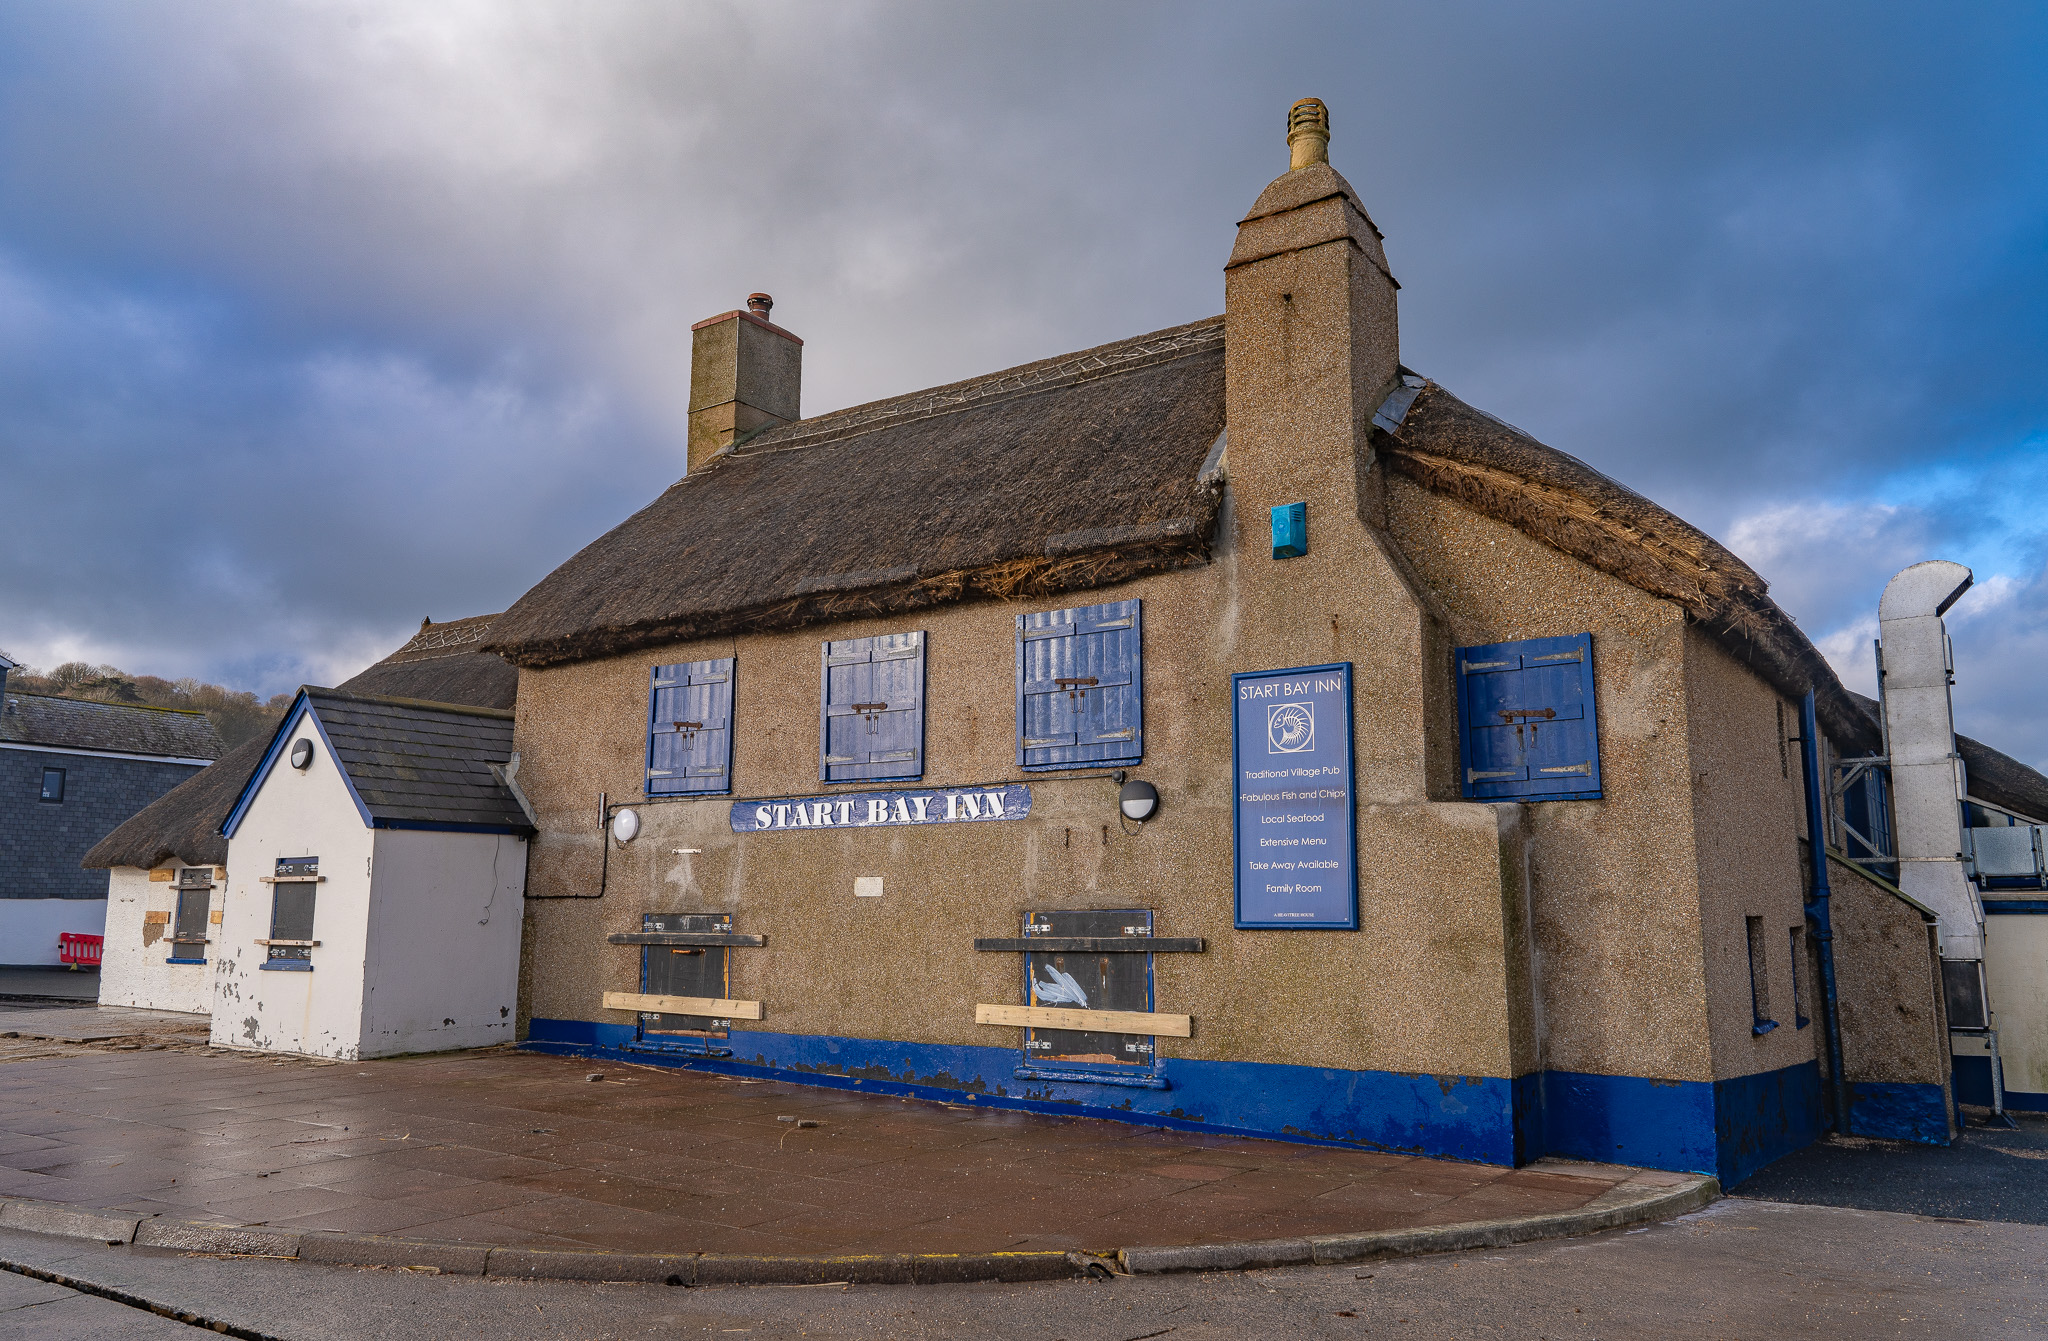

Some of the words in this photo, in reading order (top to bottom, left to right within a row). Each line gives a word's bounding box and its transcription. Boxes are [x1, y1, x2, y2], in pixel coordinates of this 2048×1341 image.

[1240, 684, 1279, 699] START
[1284, 681, 1311, 696] BAY
[1315, 678, 1341, 693] INN
[1245, 769, 1289, 779] Traditional
[1290, 767, 1321, 778] Village
[1322, 766, 1340, 775] Pub
[1242, 793, 1280, 802] Fabulous
[1281, 791, 1297, 800] Fish
[1298, 790, 1317, 799] and
[1318, 789, 1344, 799] Chips
[755, 800, 857, 831] START
[867, 796, 934, 825] BAY
[946, 792, 1009, 820] INN
[1261, 814, 1285, 824] Local
[1286, 813, 1325, 823] Seafood
[1260, 837, 1299, 847] Extensive
[1301, 837, 1327, 846] Menu
[1249, 861, 1269, 870] Take
[1270, 861, 1296, 871] Away
[1297, 860, 1339, 869] Available
[1266, 884, 1294, 894] Family
[1295, 883, 1322, 893] Room
